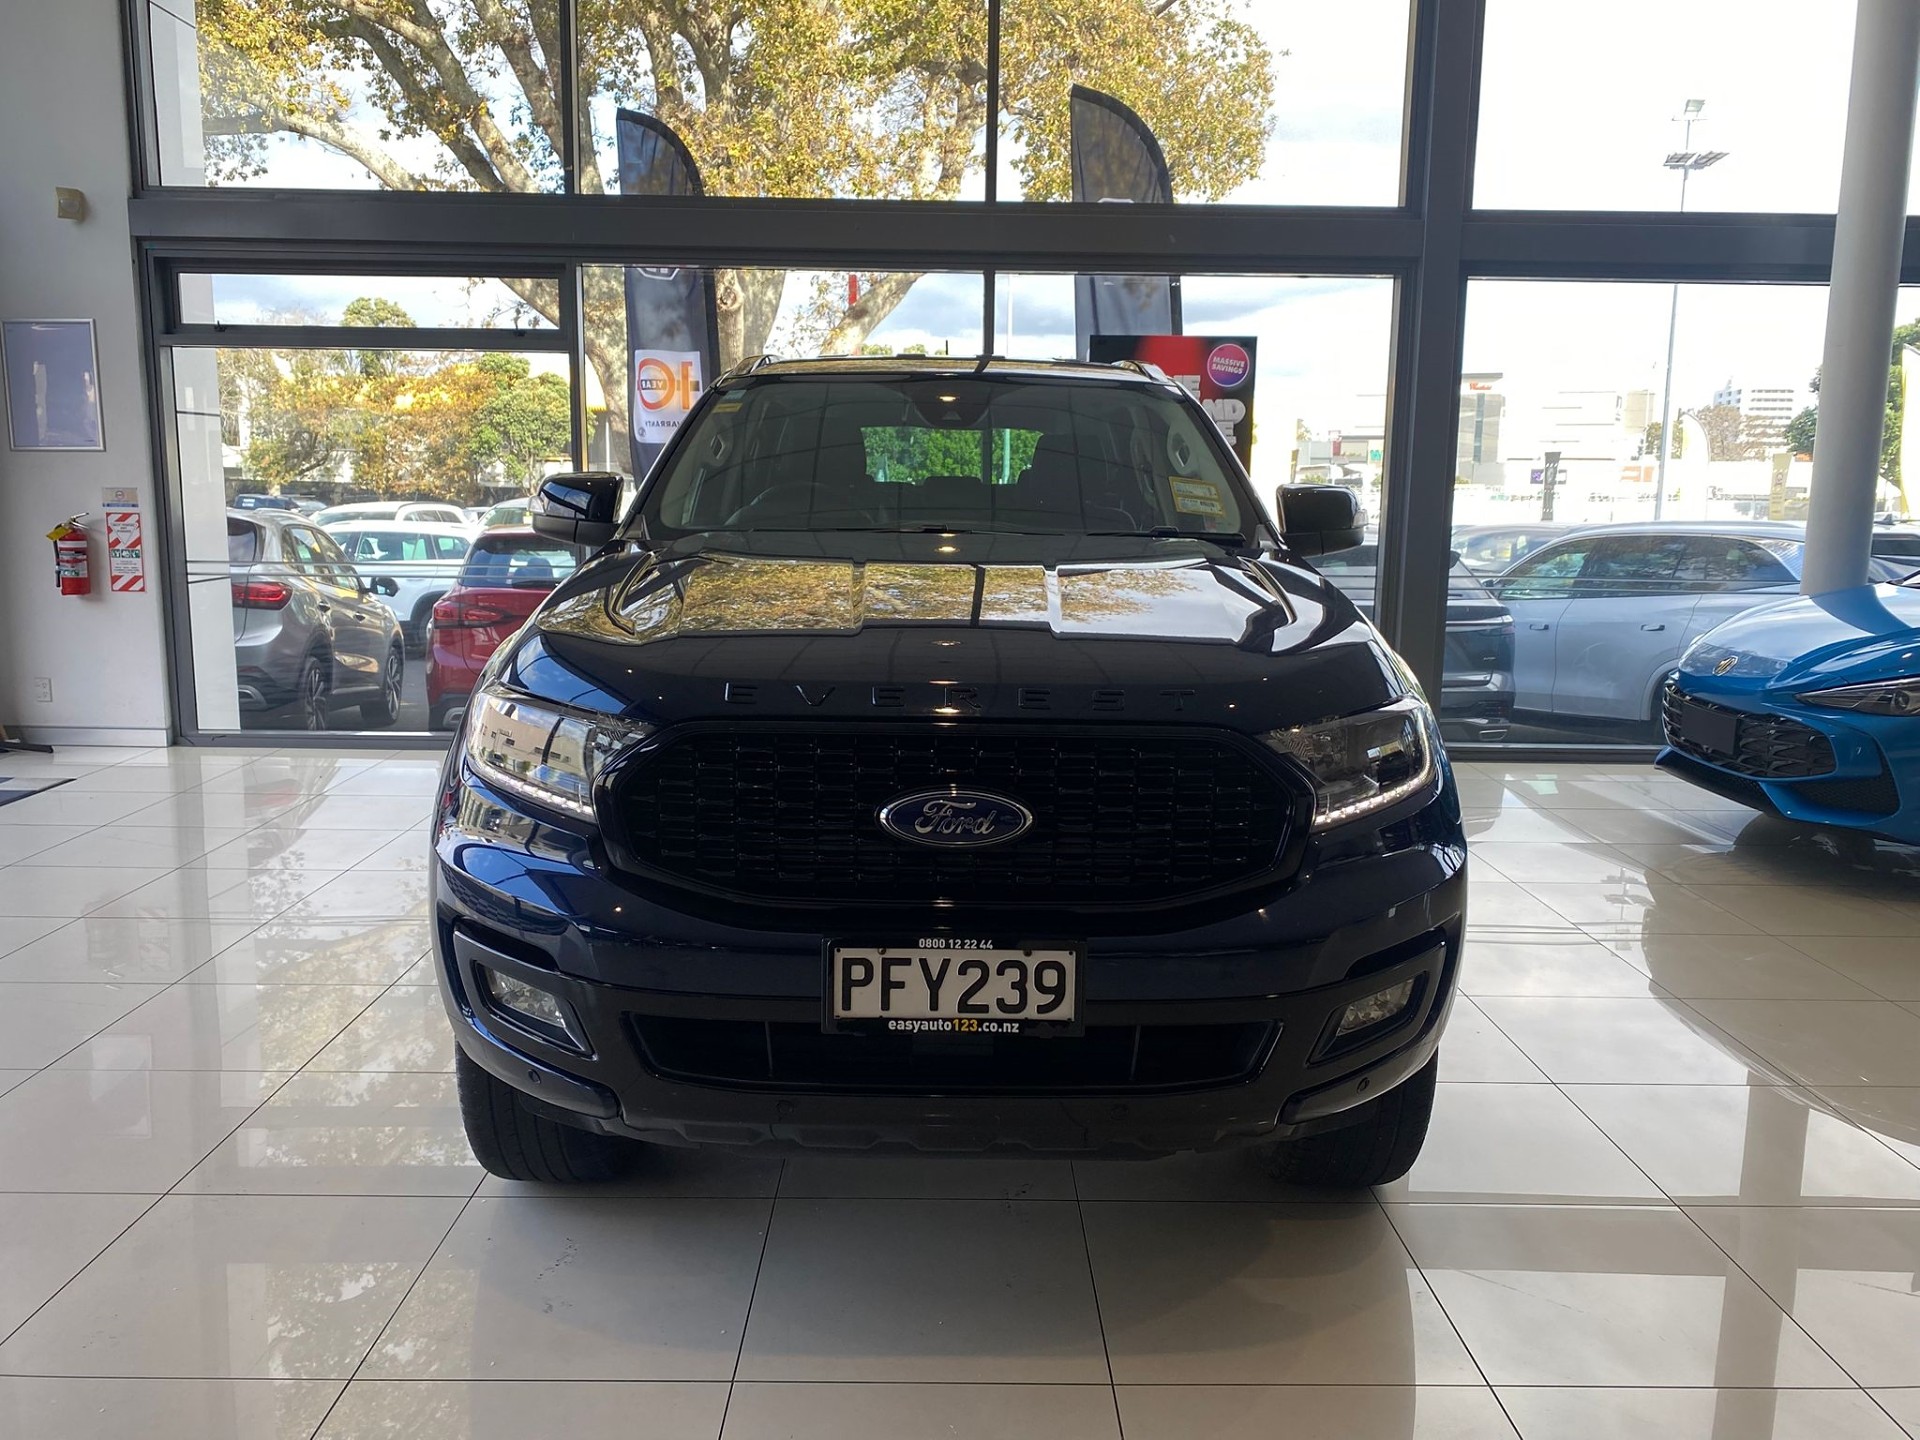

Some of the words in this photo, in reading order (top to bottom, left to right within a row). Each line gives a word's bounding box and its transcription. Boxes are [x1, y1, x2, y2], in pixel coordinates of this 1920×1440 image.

[1212, 363, 1243, 374] SAVINGS
[1213, 356, 1245, 367] MASSIVE
[723, 681, 1197, 712] EVEREST
[914, 799, 996, 837] Ford
[918, 938, 946, 949] 0800
[949, 939, 962, 949] 12
[964, 940, 977, 950] 22
[979, 939, 993, 950] 44
[841, 957, 1067, 1014] PFY239
[888, 1018, 1020, 1033] easyauto123.co.nz
